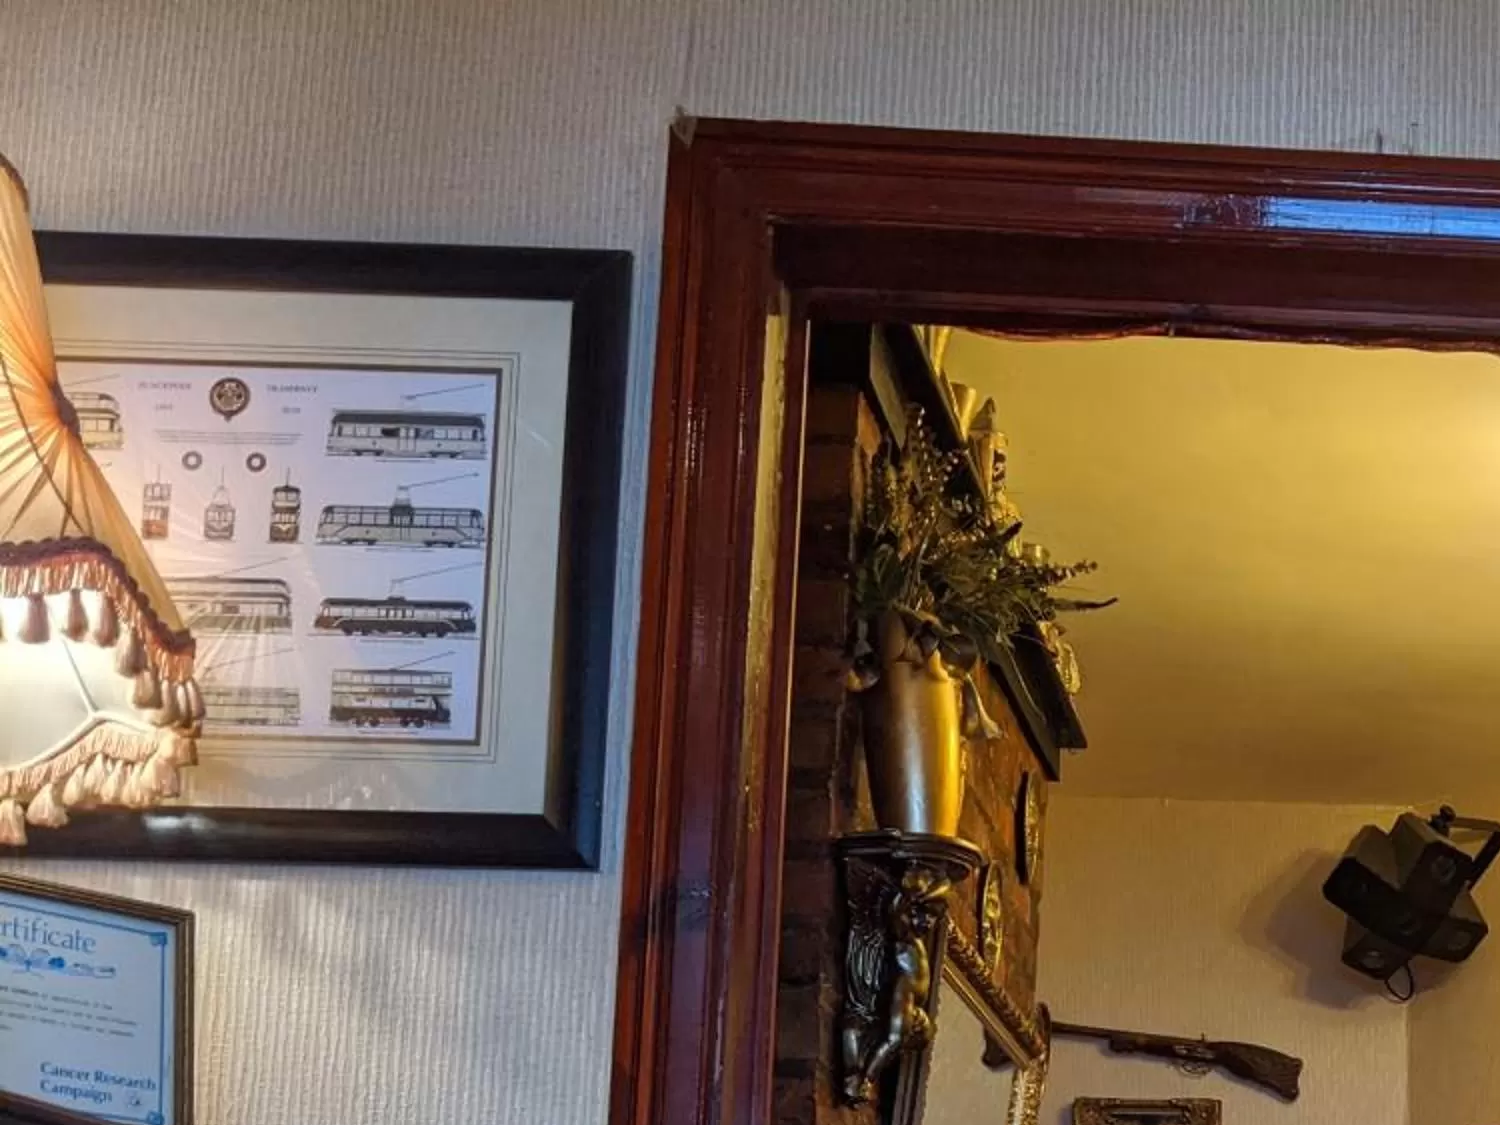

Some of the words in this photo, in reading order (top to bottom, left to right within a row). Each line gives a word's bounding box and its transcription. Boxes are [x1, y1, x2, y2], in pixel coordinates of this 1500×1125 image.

[39, 1061, 91, 1081] Cancer
[94, 1070, 157, 1090] Research
[39, 1079, 113, 1104] Campaign
